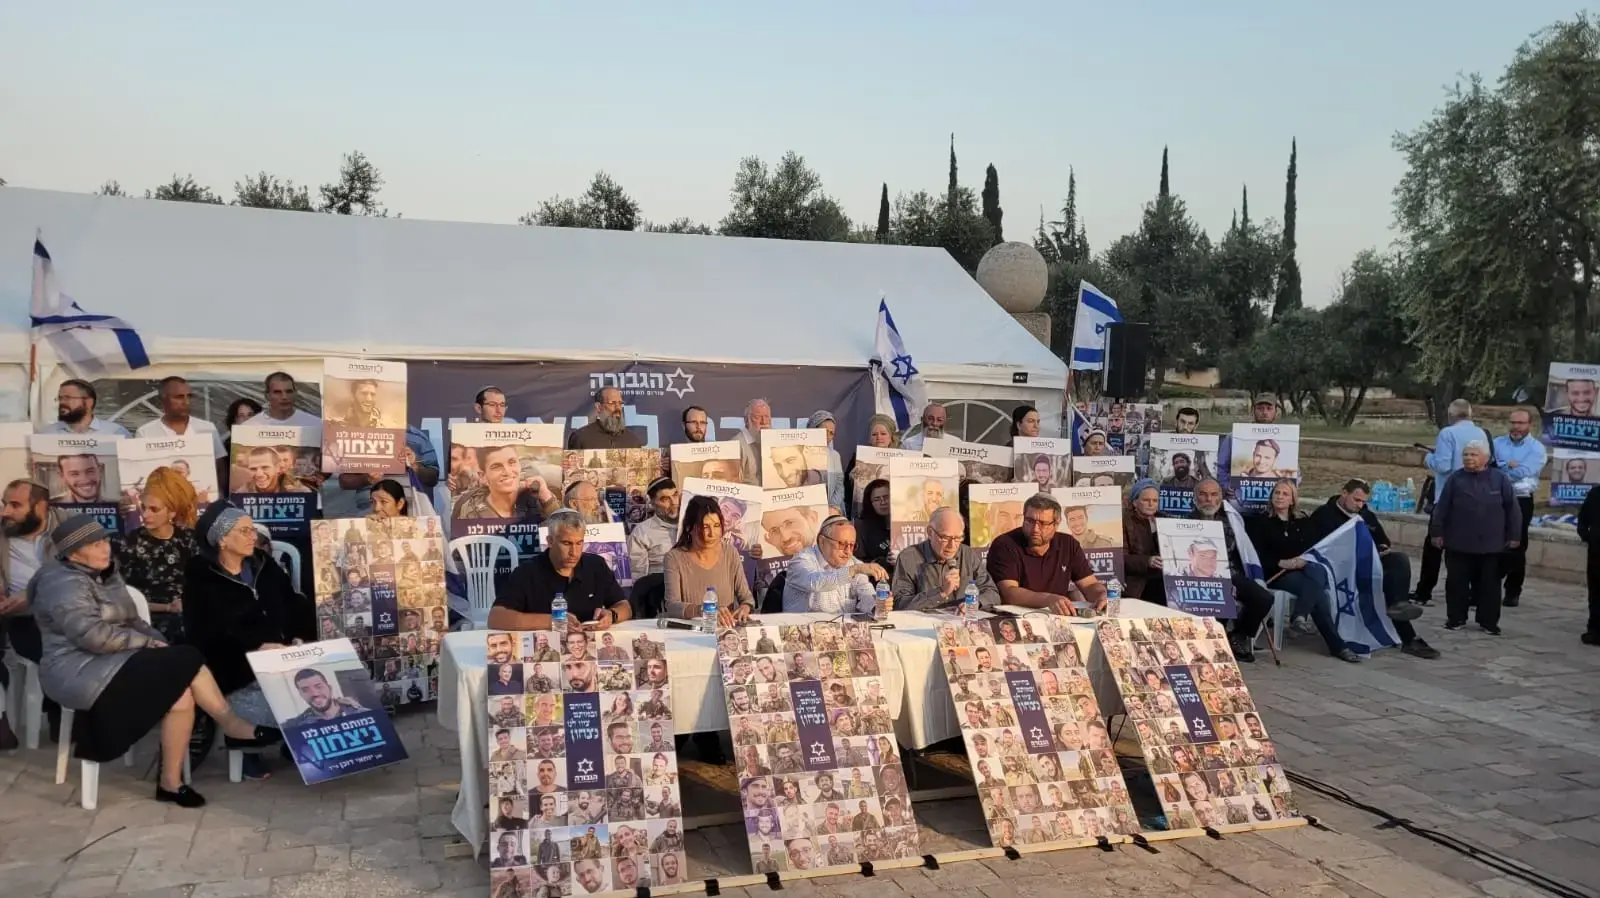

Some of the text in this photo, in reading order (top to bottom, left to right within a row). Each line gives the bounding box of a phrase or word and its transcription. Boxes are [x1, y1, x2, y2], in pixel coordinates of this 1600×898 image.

[589, 372, 664, 389] הגבורה
[336, 430, 349, 438] לנו
[485, 429, 518, 438] הגבורה
[1553, 422, 1599, 437] ניצחון
[336, 439, 394, 457] ניצחון
[949, 446, 977, 456] הגבורה
[243, 496, 256, 504] לנו
[1240, 486, 1272, 500] צחון
[1159, 496, 1192, 510] צחון
[85, 507, 117, 515] במותם
[243, 504, 304, 518] ניצחון
[467, 523, 540, 534] מותם ציוו לנו
[1176, 587, 1225, 602] ניצחון
[281, 648, 313, 660] הגבורה
[301, 716, 376, 740] במותם ציוו לנו
[307, 725, 383, 761] ניצחון
[570, 728, 599, 744] ניצחון
[574, 774, 598, 782] הגבורה
